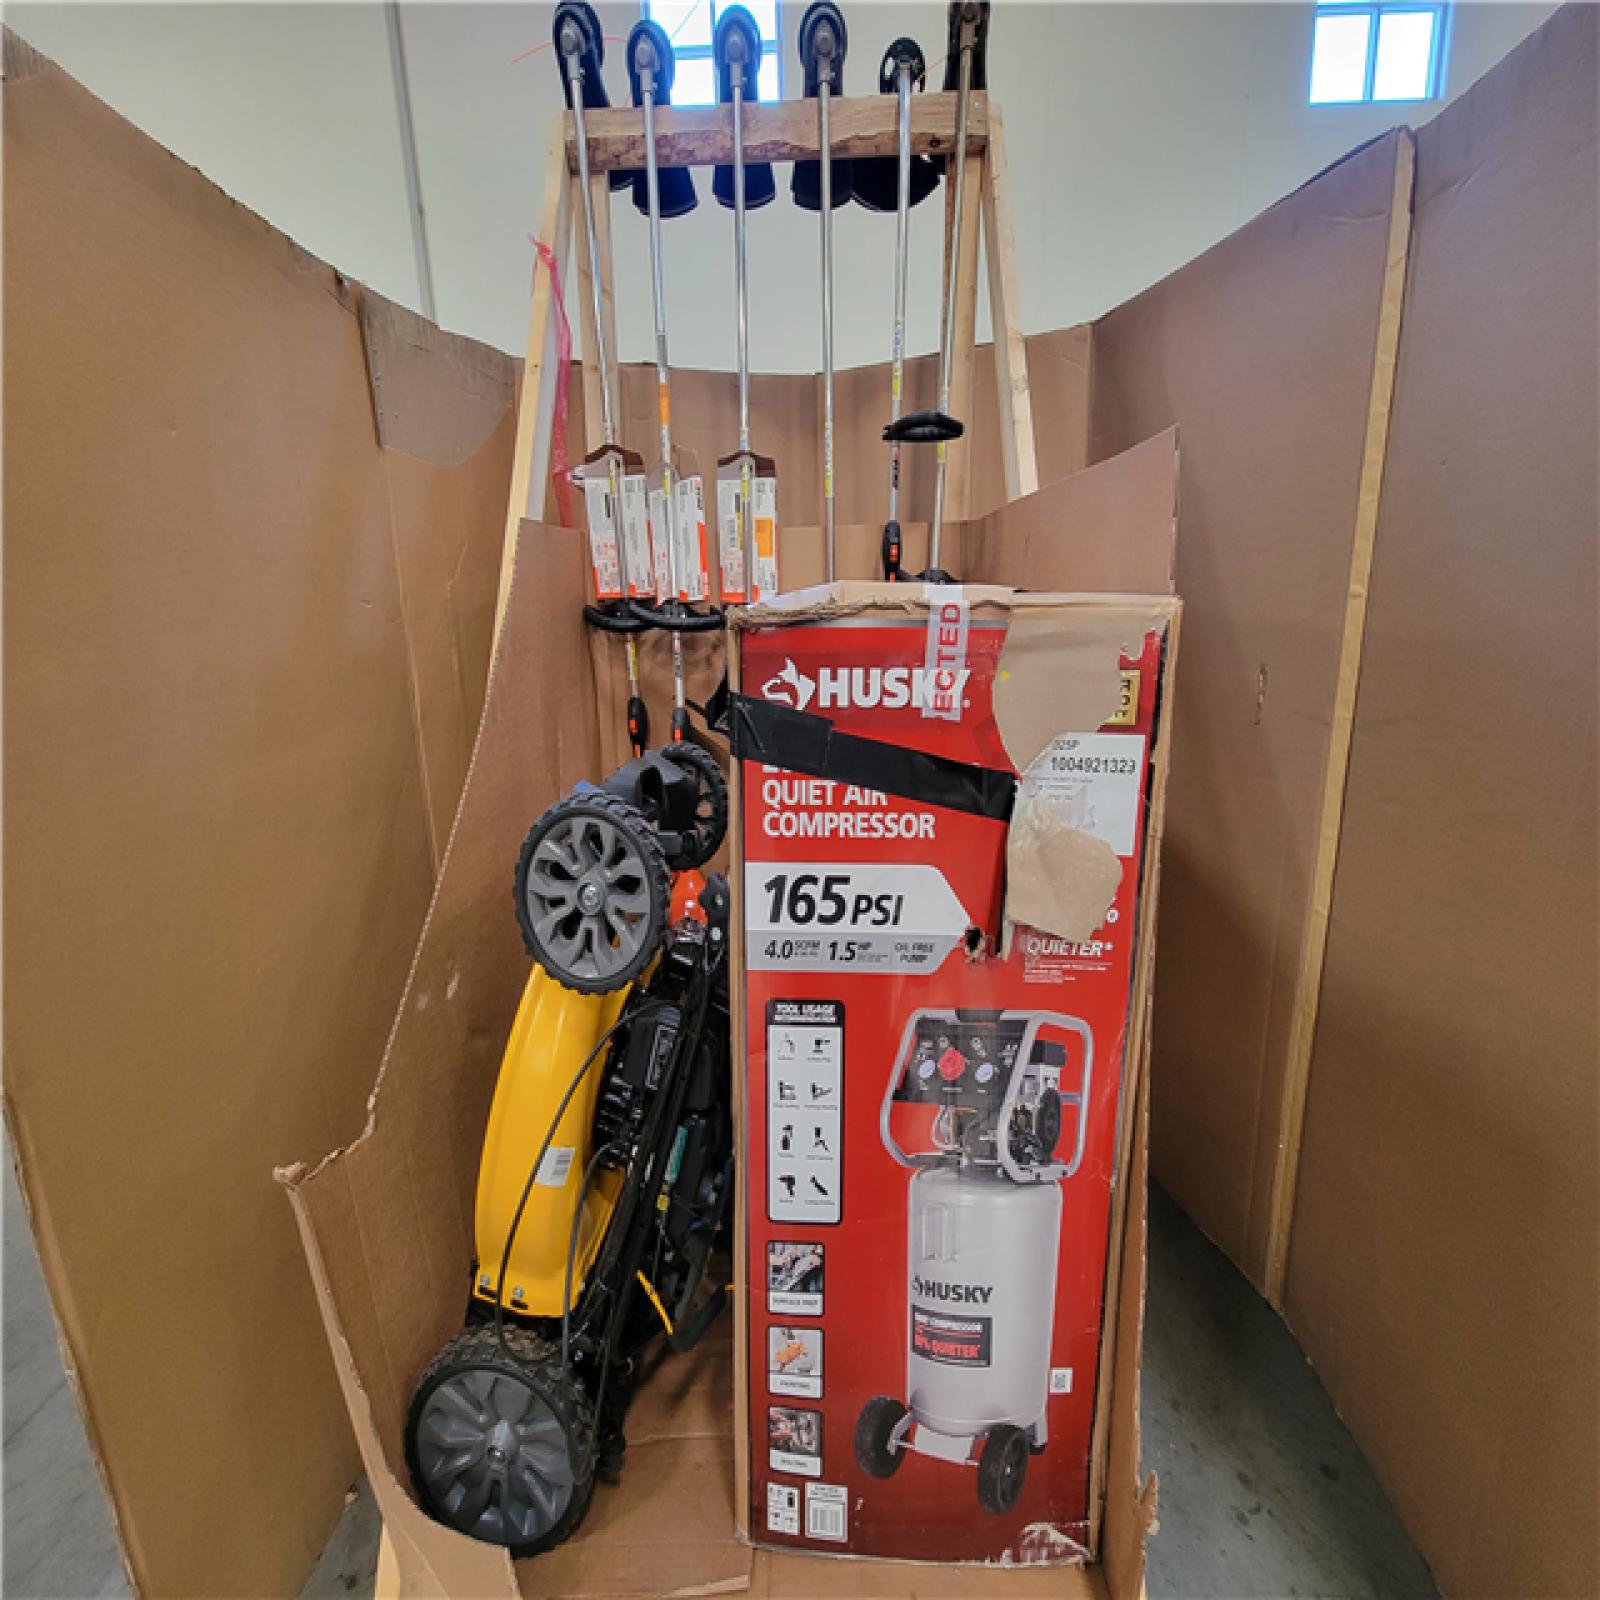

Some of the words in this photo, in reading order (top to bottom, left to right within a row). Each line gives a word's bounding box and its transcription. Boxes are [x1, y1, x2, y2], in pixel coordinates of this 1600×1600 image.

[934, 604, 960, 712] ECTED
[817, 667, 970, 708] HUSKY
[762, 779, 837, 809] QUIET
[762, 812, 936, 839] COMPRESSOR
[764, 874, 850, 926] 165
[850, 894, 903, 926] PSI
[765, 939, 793, 959] 4.0
[829, 941, 857, 961] 1.5
[924, 1279, 993, 1304] HUSKY
